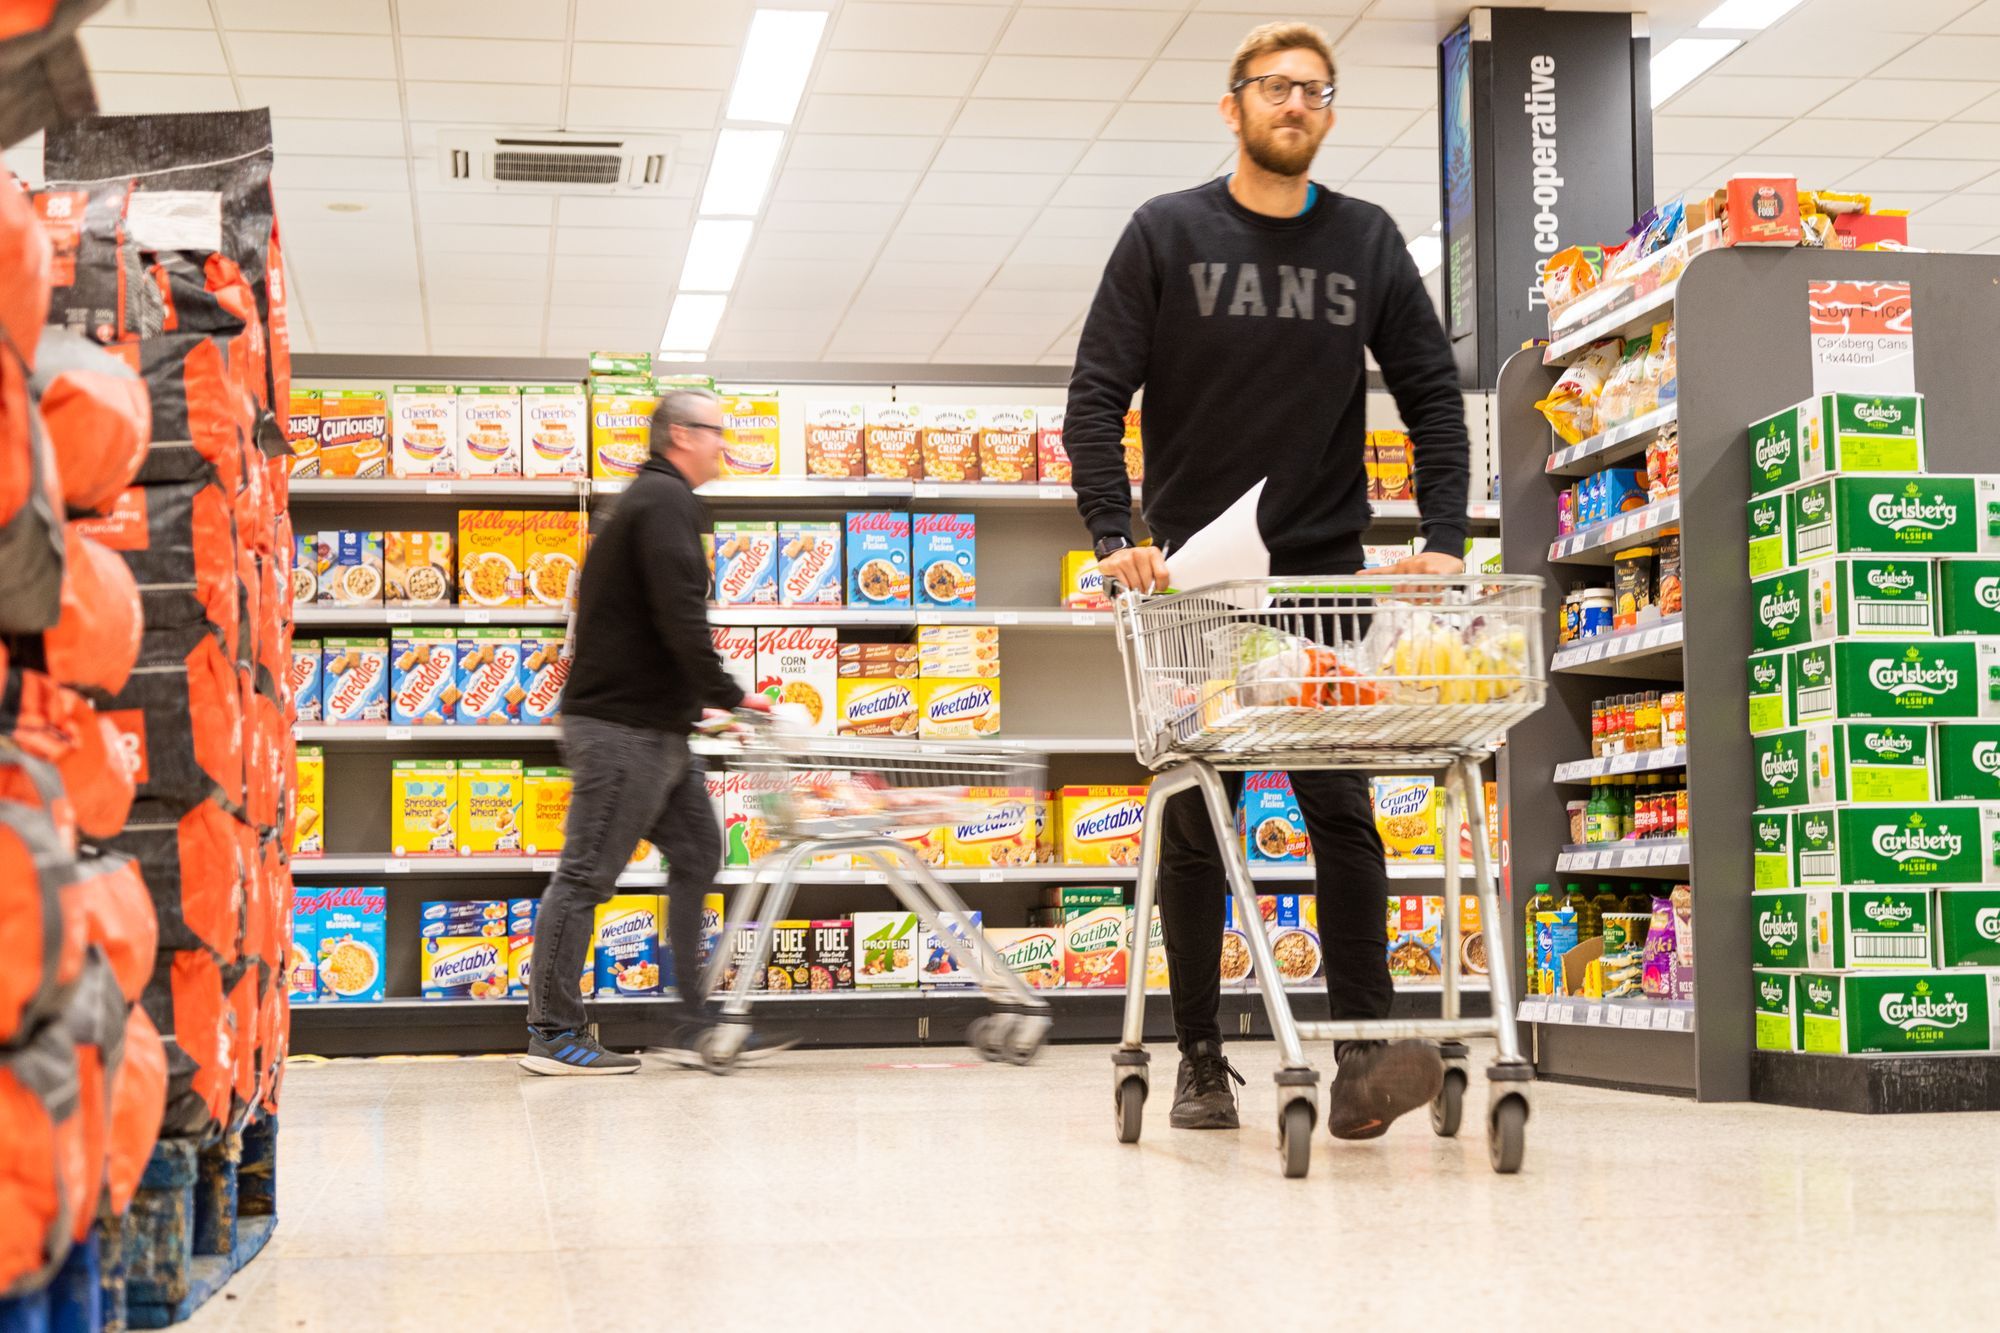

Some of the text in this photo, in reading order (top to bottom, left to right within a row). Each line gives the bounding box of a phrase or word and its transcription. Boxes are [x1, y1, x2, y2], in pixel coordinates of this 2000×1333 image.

[1525, 55, 1564, 253] co-operative
[1188, 262, 1356, 326] VANS
[1816, 301, 1854, 318] Low
[1817, 337, 1908, 351] Carlsberg Cans
[402, 407, 448, 420] Cheerios
[465, 407, 512, 420] Cheerios
[530, 407, 577, 420] Cheerios
[596, 413, 651, 428] Cheerios
[721, 414, 777, 429] Cheerios
[1854, 402, 1902, 421] Carlsberg
[322, 417, 385, 442] Curiously
[812, 430, 858, 444] COUNTRY
[870, 430, 917, 445] COUNTRY
[927, 432, 973, 447] COUNTRY
[985, 433, 1031, 447] COUNTRY
[1756, 430, 1791, 469] Carlsberg
[1802, 493, 1825, 514] Carlsberg
[1868, 494, 1957, 527] Carlsberg
[460, 510, 524, 537] Kellogg
[848, 512, 910, 537] Kellogg
[1754, 506, 1775, 526] Carlsberg
[914, 514, 976, 540] Kellogg
[1895, 532, 1933, 540] PILSNER
[1867, 569, 1914, 588] Carlsberg
[1760, 590, 1800, 627] Carlsberg
[758, 627, 838, 660] Kellogg
[781, 656, 806, 666] CORN
[781, 666, 806, 674] FLAKES
[1803, 656, 1825, 677] Carlsberg
[1754, 663, 1775, 684] Carlsberg
[1868, 659, 1958, 692] Carlsberg
[849, 690, 911, 719] Weetabix
[931, 689, 992, 719] Weetabix
[1895, 696, 1934, 705] PILSNER
[857, 725, 890, 735] Chocolate
[1864, 733, 1912, 752] Carlsberg
[1761, 750, 1799, 785] Carlsberg
[1110, 787, 1129, 796] PACK
[1263, 792, 1282, 800] Bran
[1380, 787, 1429, 810] Crunchy
[404, 799, 447, 808] Shredded
[470, 799, 512, 808] Shredded
[1260, 800, 1285, 808] Flakes
[1390, 802, 1419, 816] Bran
[1077, 805, 1145, 837] Weetabix
[1759, 822, 1781, 840] Carlsberg
[1806, 821, 1829, 840] Carlsberg
[1872, 825, 1962, 858] Carlsberg
[1899, 863, 1937, 871] PILSNER
[317, 887, 386, 914] Kellogg
[1864, 901, 1912, 921] Carlsberg
[601, 914, 654, 939] Weetabix
[1070, 921, 1122, 946] Oatibix
[1759, 911, 1798, 946] Carlsberg
[608, 942, 645, 956] CRUNCH
[773, 929, 806, 952] FUEL
[815, 929, 849, 951] FUEL
[863, 940, 909, 949] PROTEIN
[434, 948, 499, 978] Weetabix
[1761, 981, 1783, 1001] Carlsberg
[1808, 983, 1832, 1003] Carlsberg
[1879, 993, 1968, 1026] Carlsberg
[1905, 1031, 1944, 1039] PILSNER
